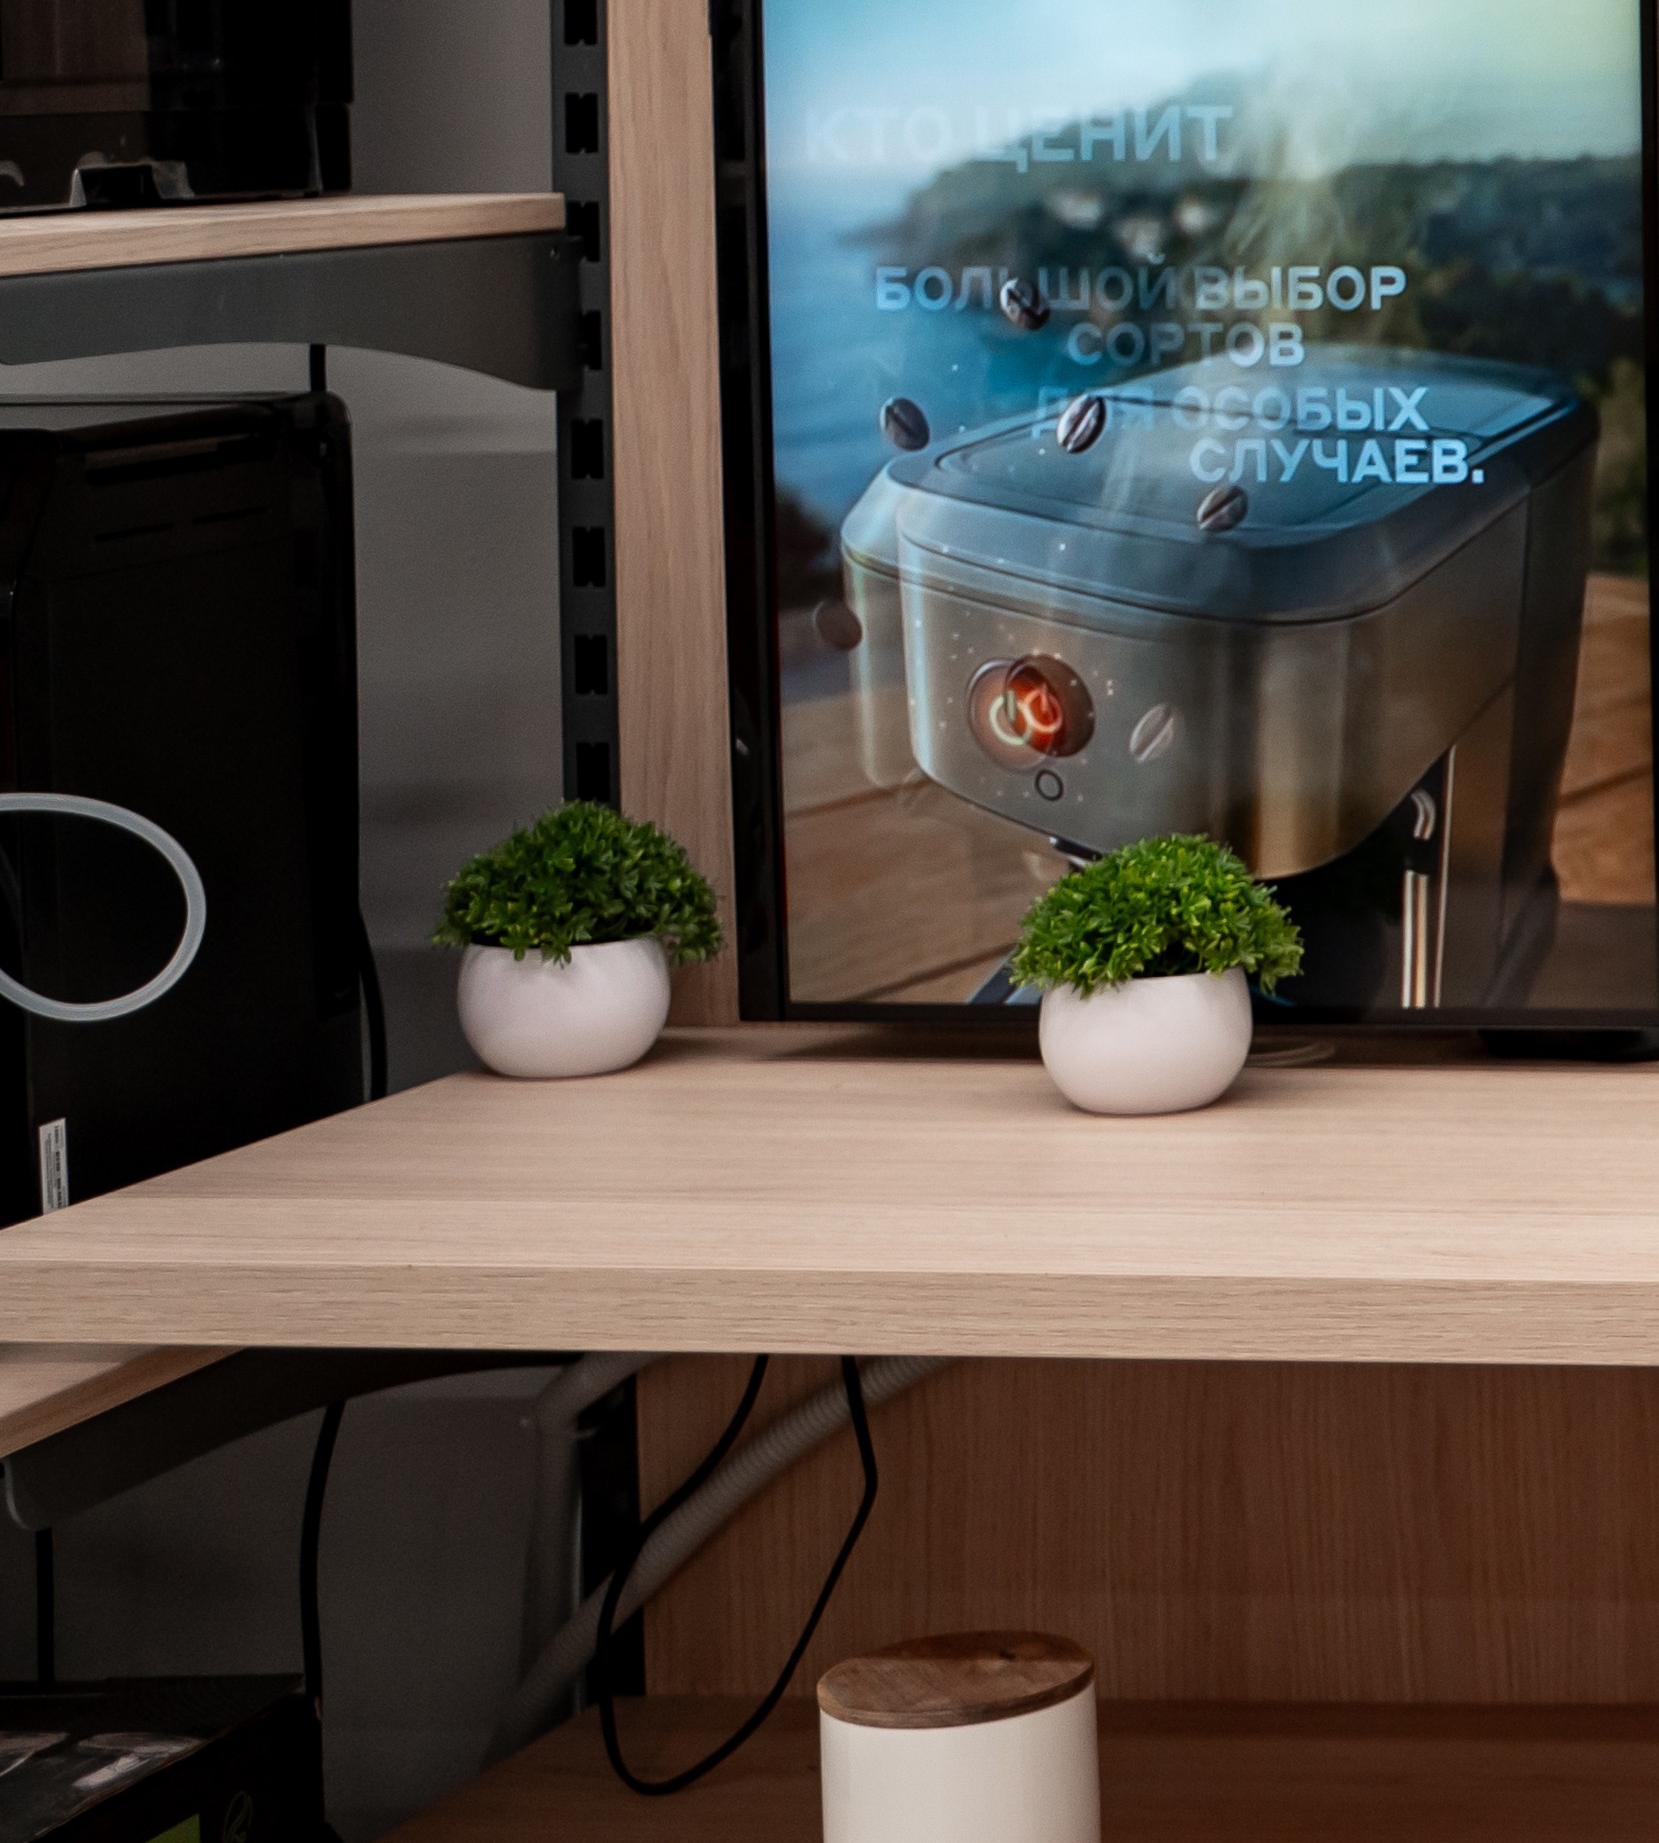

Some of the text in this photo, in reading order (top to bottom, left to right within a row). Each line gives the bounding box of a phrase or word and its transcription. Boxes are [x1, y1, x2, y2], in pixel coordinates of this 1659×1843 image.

[973, 103, 1234, 174] ЦЕНИТ
[1066, 321, 1306, 368] СОРТОВ
[1171, 386, 1428, 432] ОСОБЫХ
[1188, 438, 1486, 486] СЛУЧАЕВ.
